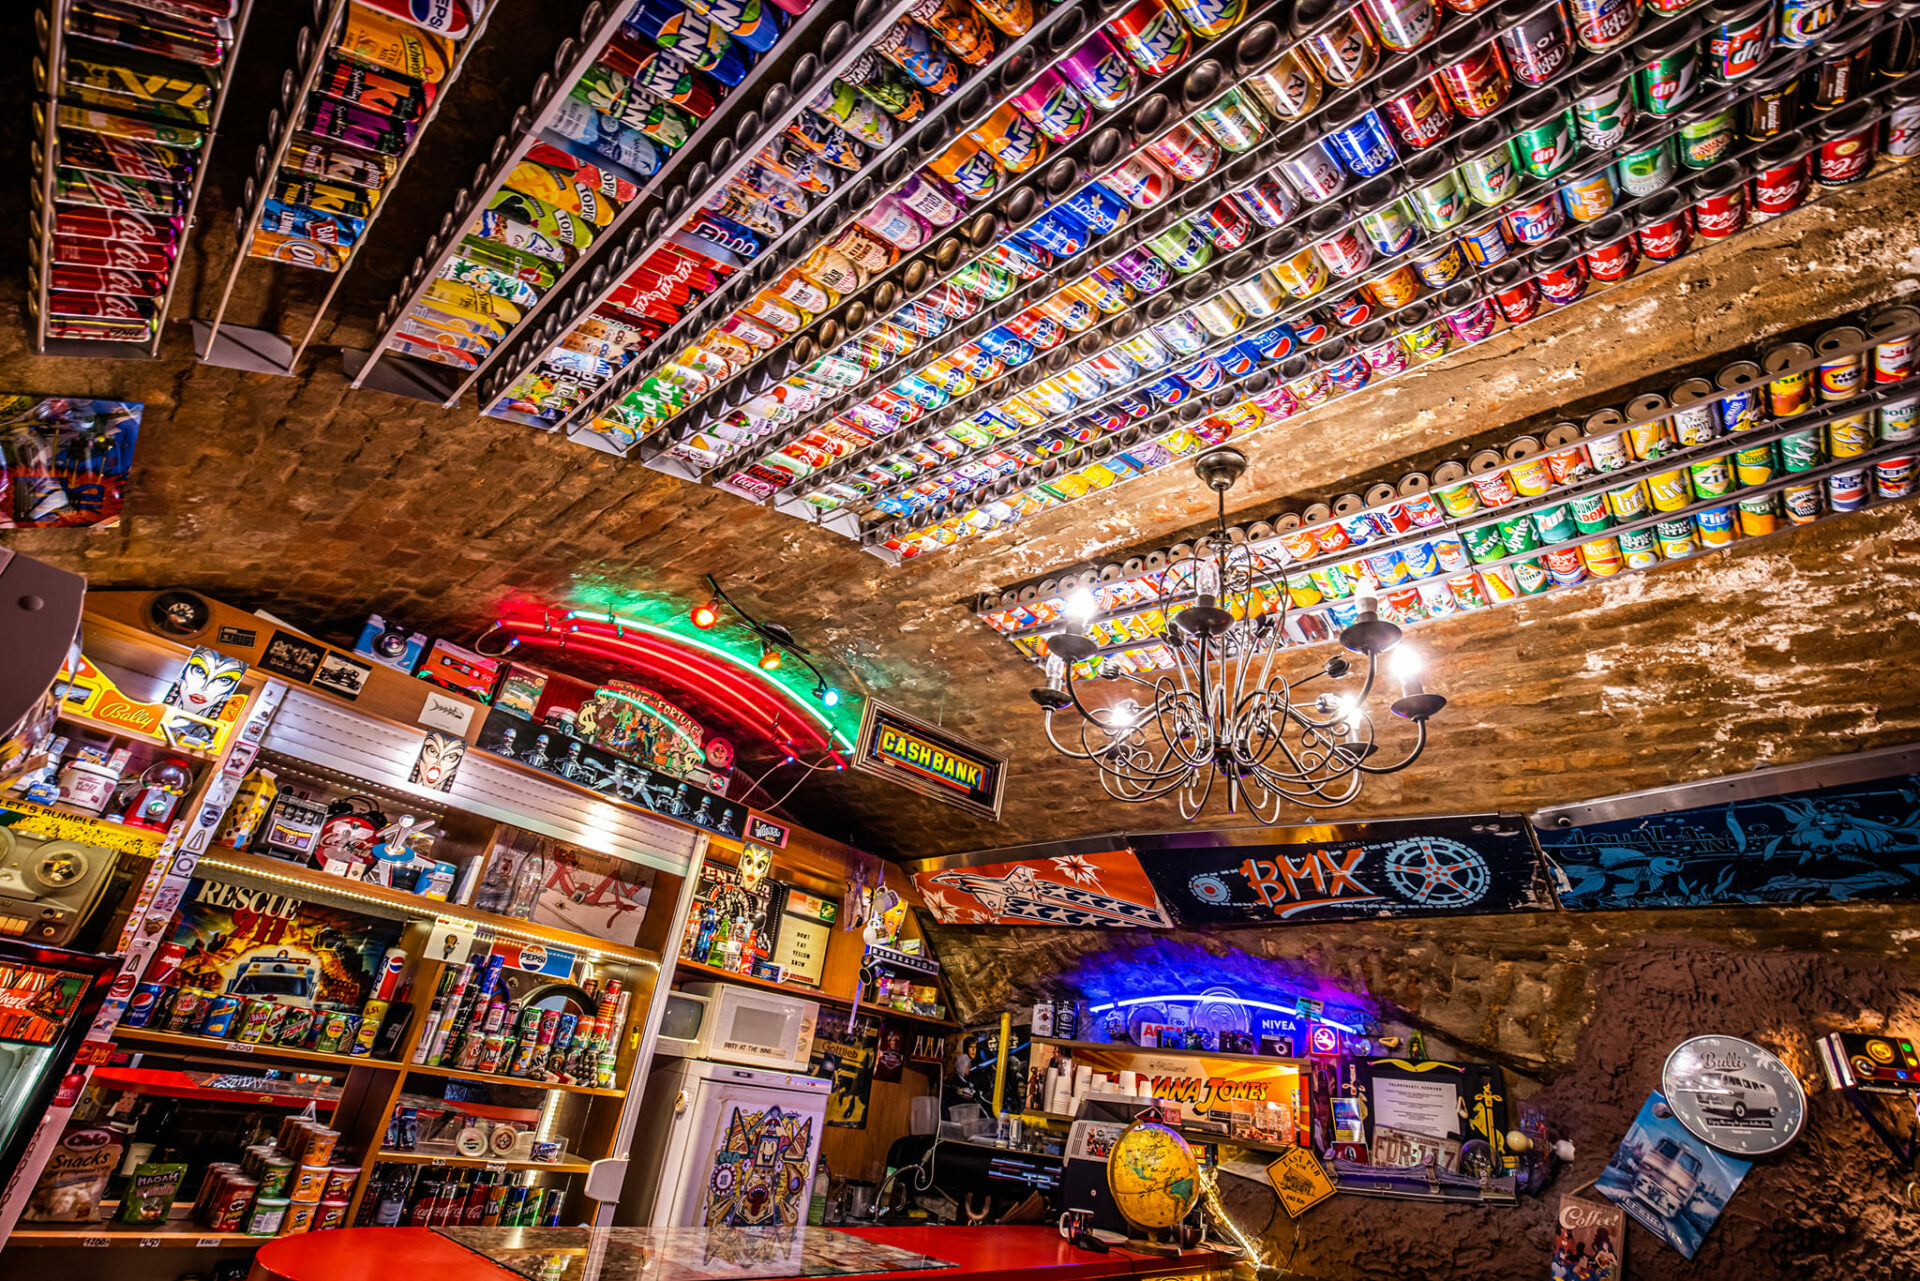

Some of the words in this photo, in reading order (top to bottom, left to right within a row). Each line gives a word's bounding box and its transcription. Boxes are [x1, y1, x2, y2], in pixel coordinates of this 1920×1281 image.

[1506, 518, 1529, 554] Sprite
[481, 674, 493, 683] 90
[100, 702, 155, 730] Bally
[43, 808, 99, 827] RUMBLE
[1240, 848, 1376, 907] BMX
[195, 880, 303, 922] RESCUE
[230, 903, 291, 945] 911
[520, 951, 547, 964] PEPSI
[372, 955, 389, 992] PEPSI
[1262, 1019, 1297, 1032] NIVEA
[821, 1041, 859, 1059] Gottlieb
[1701, 1051, 1748, 1071] Bulli
[1193, 1077, 1269, 1116] JONES
[51, 1152, 111, 1170] Snacks
[137, 1171, 181, 1187] MAOAM
[1559, 1206, 1619, 1230] Coffee!
